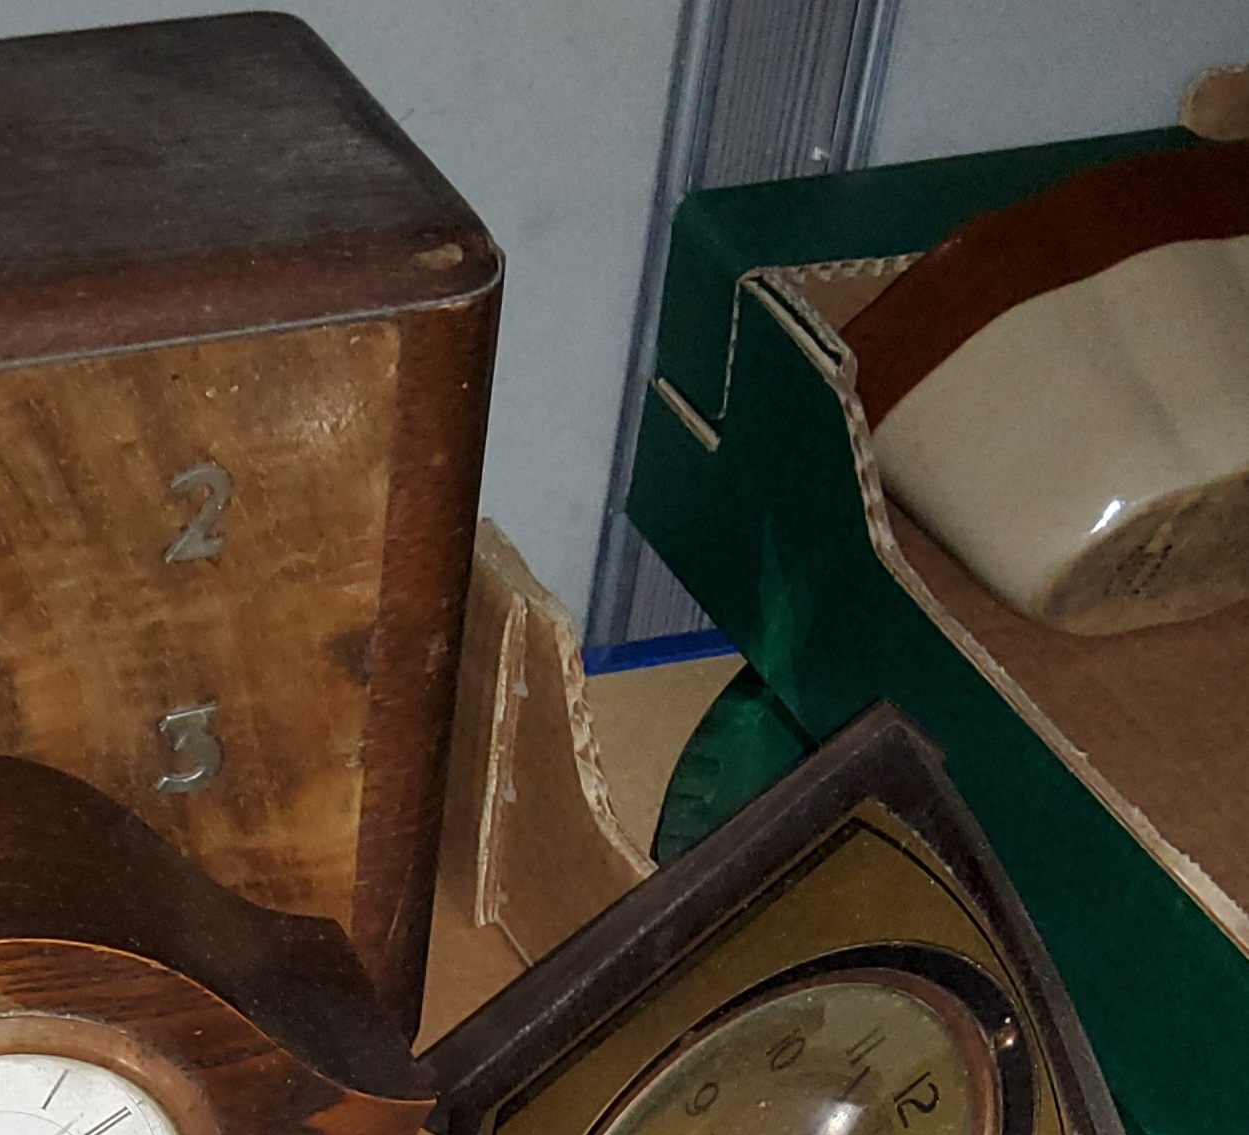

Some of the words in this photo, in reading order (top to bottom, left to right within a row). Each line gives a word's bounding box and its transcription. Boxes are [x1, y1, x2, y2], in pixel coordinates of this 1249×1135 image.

[165, 462, 231, 563] 2
[155, 702, 222, 793] 3
[893, 1071, 940, 1128] 12
